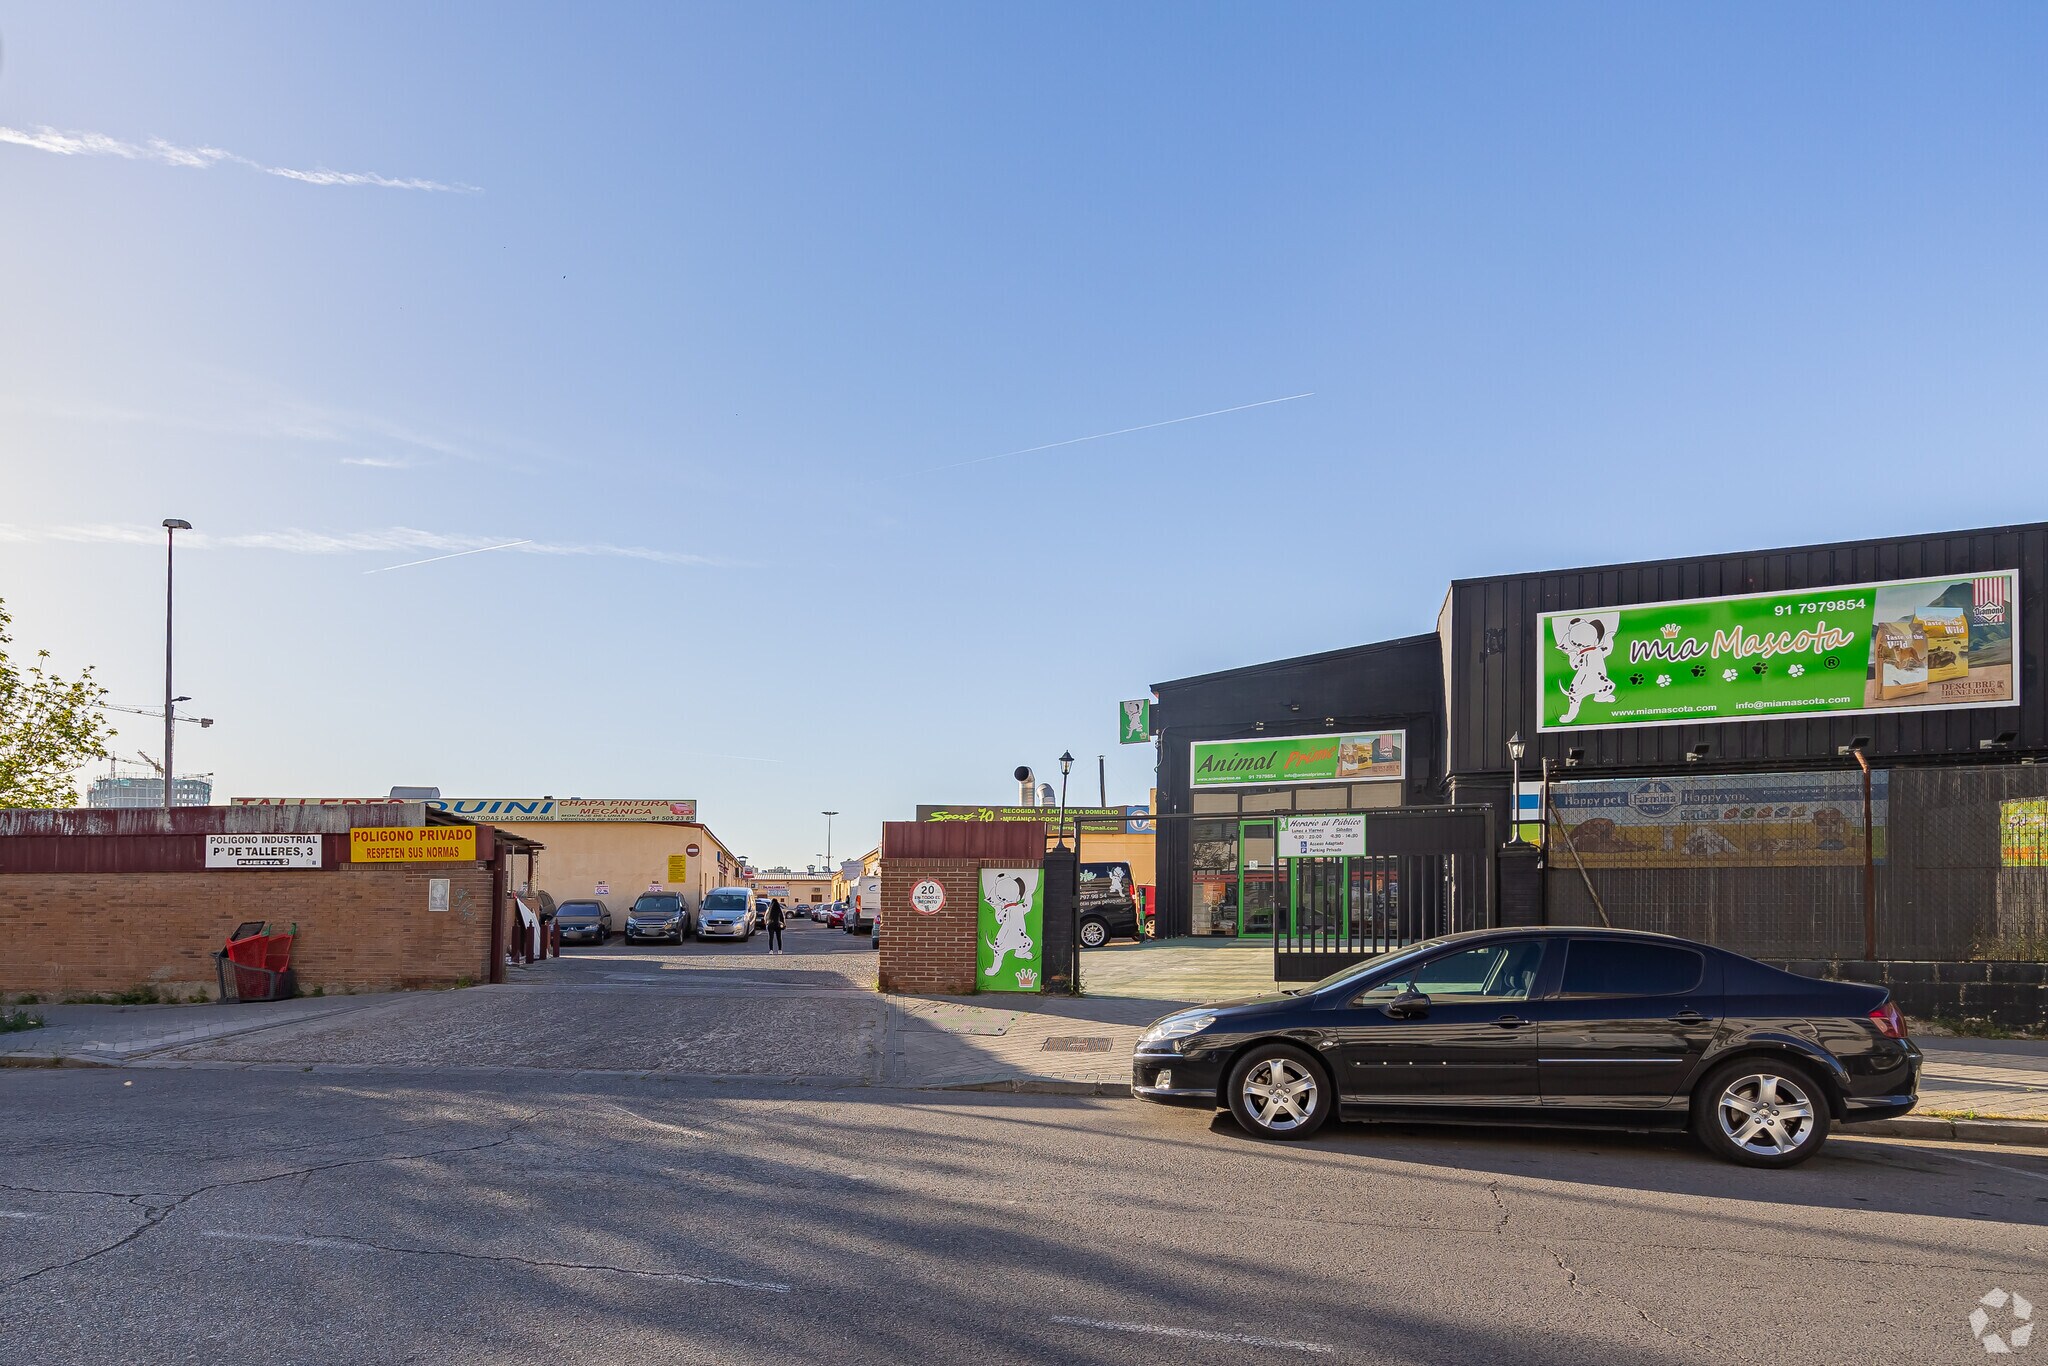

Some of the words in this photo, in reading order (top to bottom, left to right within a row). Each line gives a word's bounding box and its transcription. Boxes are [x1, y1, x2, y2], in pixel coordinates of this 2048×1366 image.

[1774, 605, 1792, 616] 91
[1798, 598, 1866, 614] 7979854
[1945, 626, 1965, 634] Wild
[1630, 637, 1709, 664] mia
[1711, 620, 1855, 659] Mascota
[1941, 681, 1996, 690] DESCUBRE
[1611, 704, 1717, 717] www.miamascota.com
[1735, 696, 1850, 710] info@miamascota.com
[1197, 750, 1278, 773] Animal
[1283, 745, 1337, 770] Prime
[1565, 796, 1600, 806] Happy
[1603, 795, 1625, 807] pet.
[1684, 793, 1722, 803] Happy
[926, 811, 977, 822] Sport
[977, 808, 995, 822] 70
[1290, 820, 1320, 828] Horario
[210, 836, 258, 844] POLIGONO
[262, 836, 317, 844] INDUSTRIAL
[354, 831, 414, 842] POLIGONO
[420, 829, 473, 841] PRIVADO
[228, 847, 242, 856] DE
[246, 847, 303, 857] TALLERES,
[306, 847, 314, 856] 3
[367, 848, 405, 858] RESPETEN
[408, 847, 423, 858] SUS
[427, 846, 460, 858] NORMAS
[921, 885, 935, 894] 20
